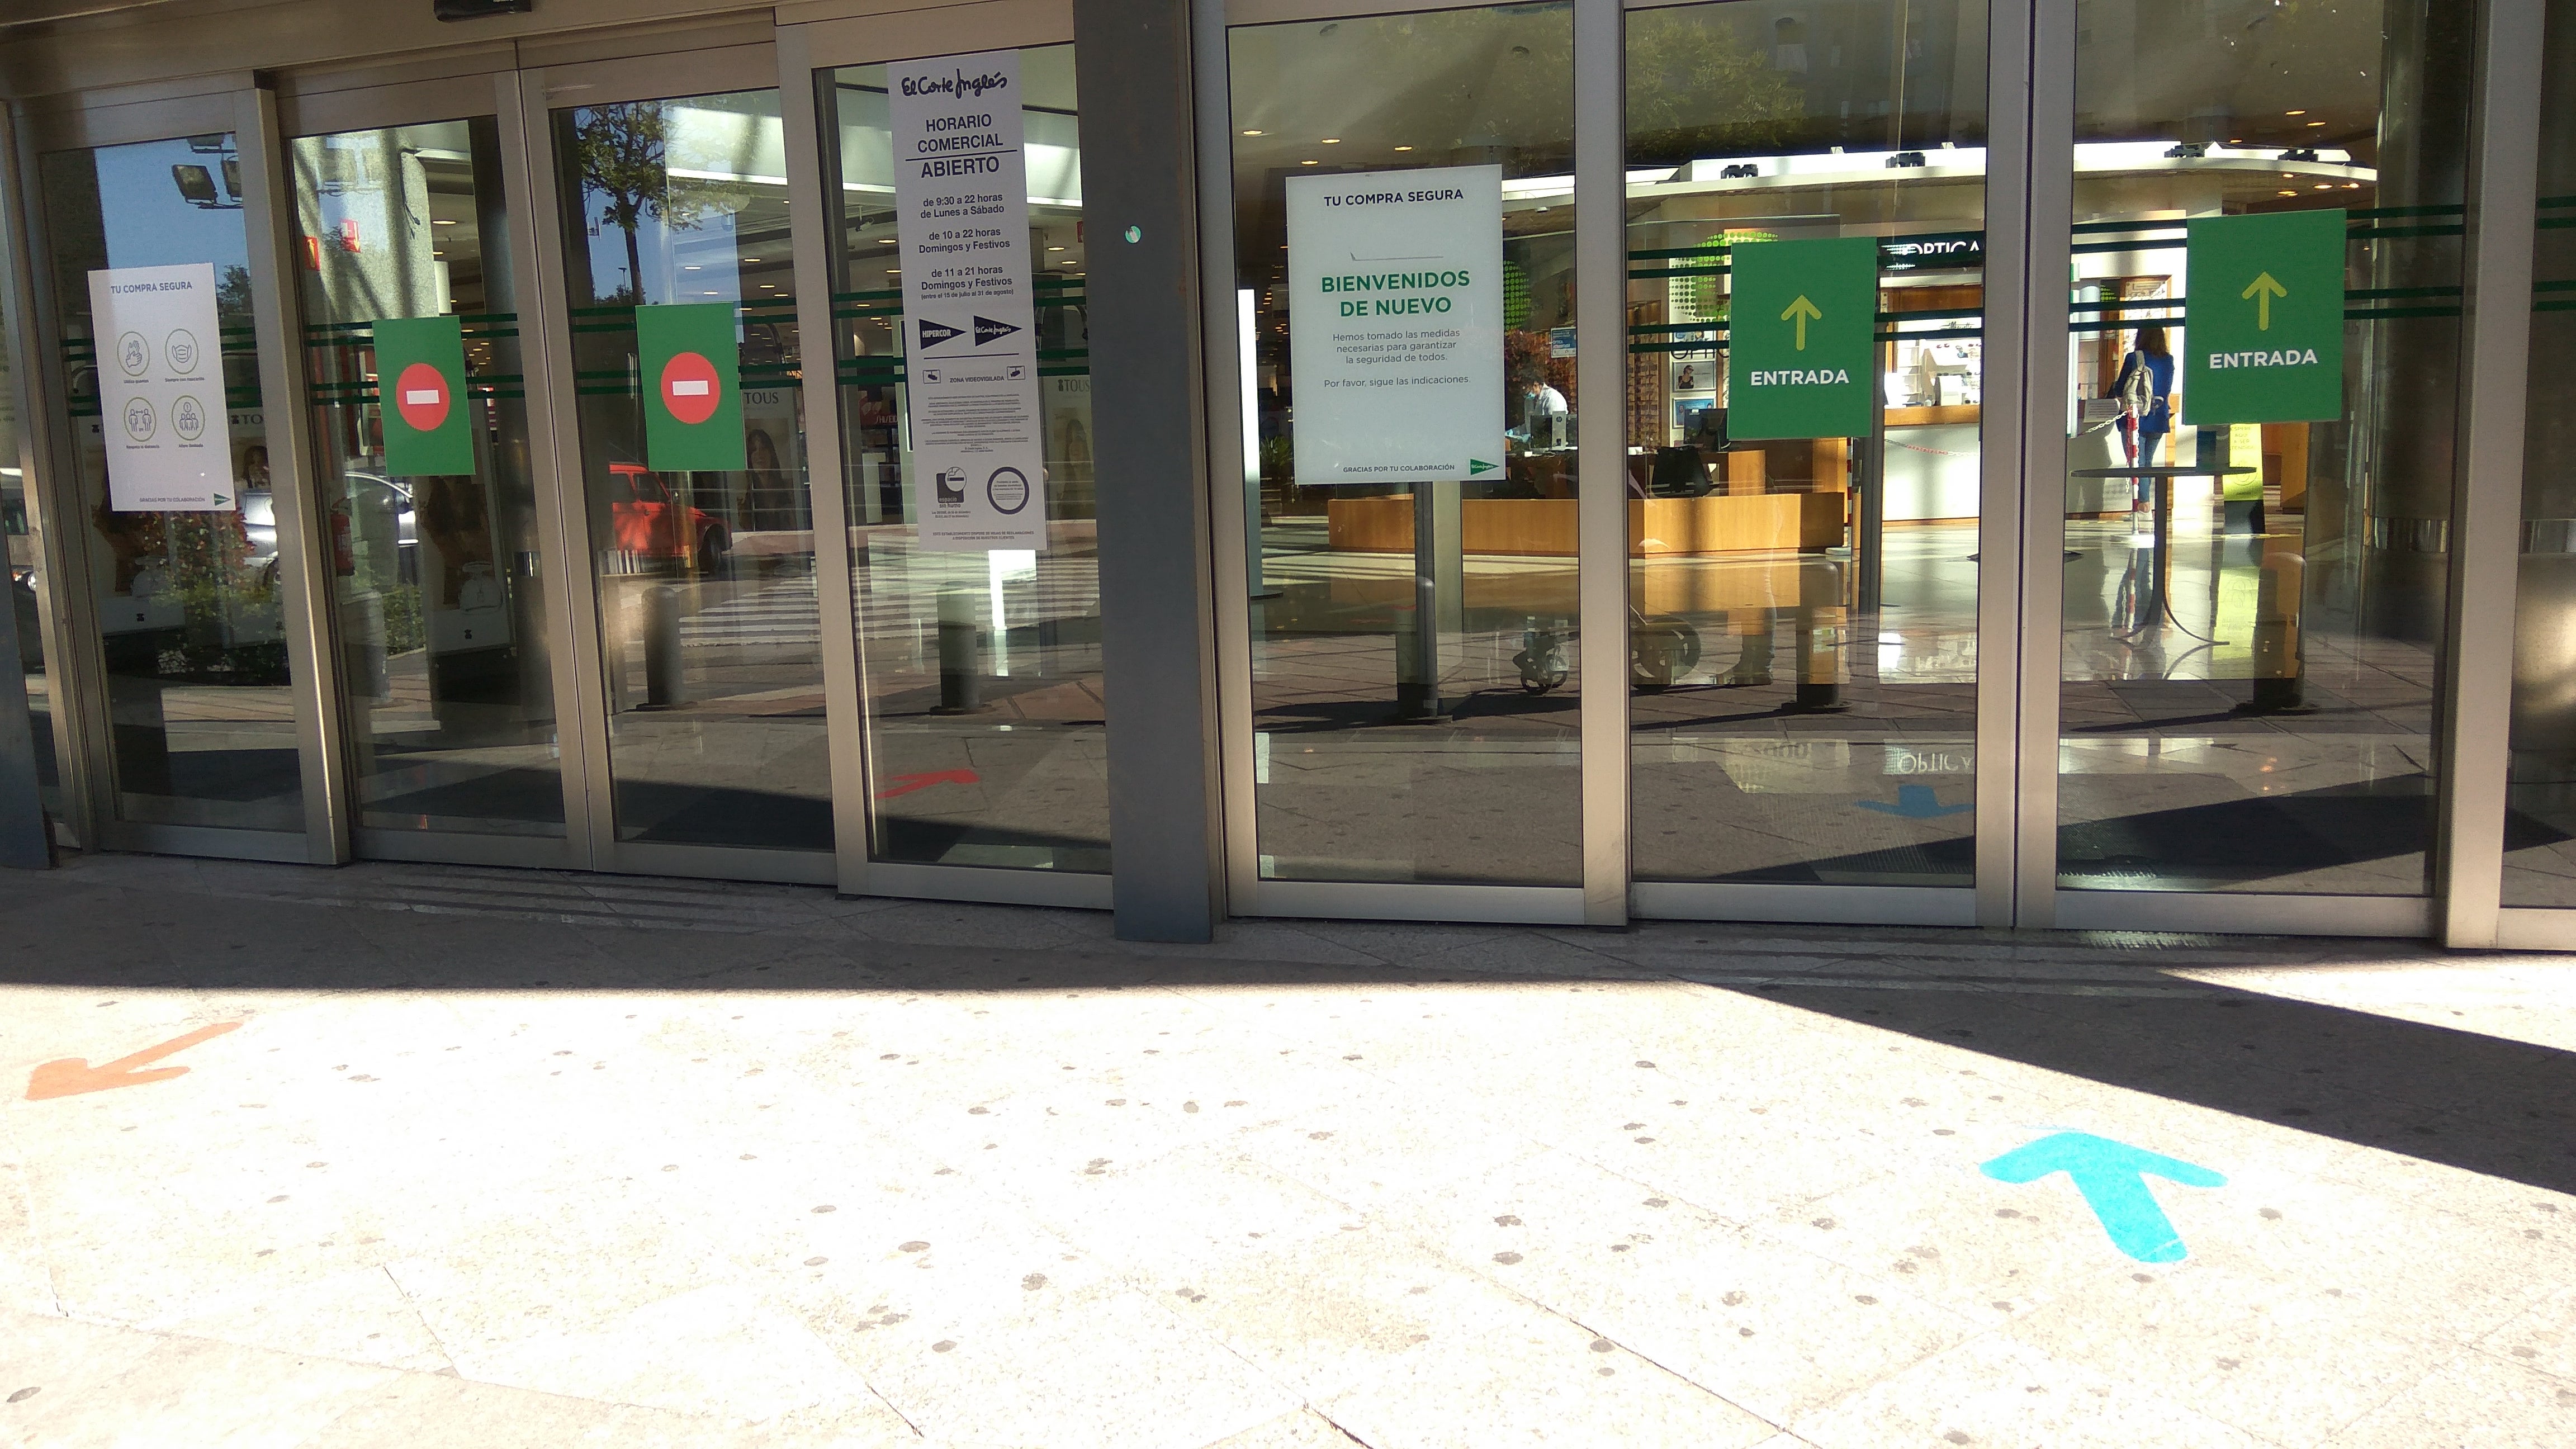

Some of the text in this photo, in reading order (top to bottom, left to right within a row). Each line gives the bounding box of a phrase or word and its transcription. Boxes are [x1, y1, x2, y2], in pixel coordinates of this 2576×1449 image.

[901, 68, 1007, 99] El Corte Inglés
[926, 113, 991, 132] HORARIO
[918, 133, 1003, 153] COMERCIAL
[921, 156, 1000, 178] ABIERTO
[923, 198, 934, 207] de
[936, 196, 954, 206] 9:30
[964, 195, 975, 203] 22
[977, 194, 1003, 202] horas
[1324, 189, 1464, 206] TU COMPRA SEGURA
[921, 210, 931, 219] de
[934, 209, 960, 217] Lunes
[970, 205, 1005, 215] Sábado
[929, 232, 940, 240] de
[943, 230, 953, 239] 10
[963, 229, 973, 238] 22
[976, 229, 1001, 237] horas
[919, 240, 1010, 254] Domingos y Festivos
[931, 269, 942, 277] de
[945, 268, 954, 277] 11
[965, 267, 974, 275] 21
[978, 266, 1003, 274] horas
[124, 283, 157, 293] COMPRA
[160, 281, 192, 291] SEGURA
[921, 280, 965, 290] Domingos
[976, 277, 1012, 287] Festivos
[1322, 271, 1470, 292] BIENVENIDOS
[1341, 297, 1451, 316] DE NUEVO
[922, 329, 951, 338] HIPERCOR
[1367, 331, 1403, 340] tomado
[1420, 329, 1460, 338] medidas
[1337, 341, 1456, 352] necesarias para garantizar
[1356, 354, 1401, 364] seguridad
[1419, 353, 1447, 361] todos.
[2209, 349, 2318, 369] ENTRADA
[1343, 378, 1366, 387] favor,
[1370, 378, 1394, 387] sigue
[1396, 377, 1409, 385] las
[1412, 375, 1471, 385] indicaciones.
[1751, 369, 1850, 386] ENTRADA
[744, 392, 778, 404] TOUS
